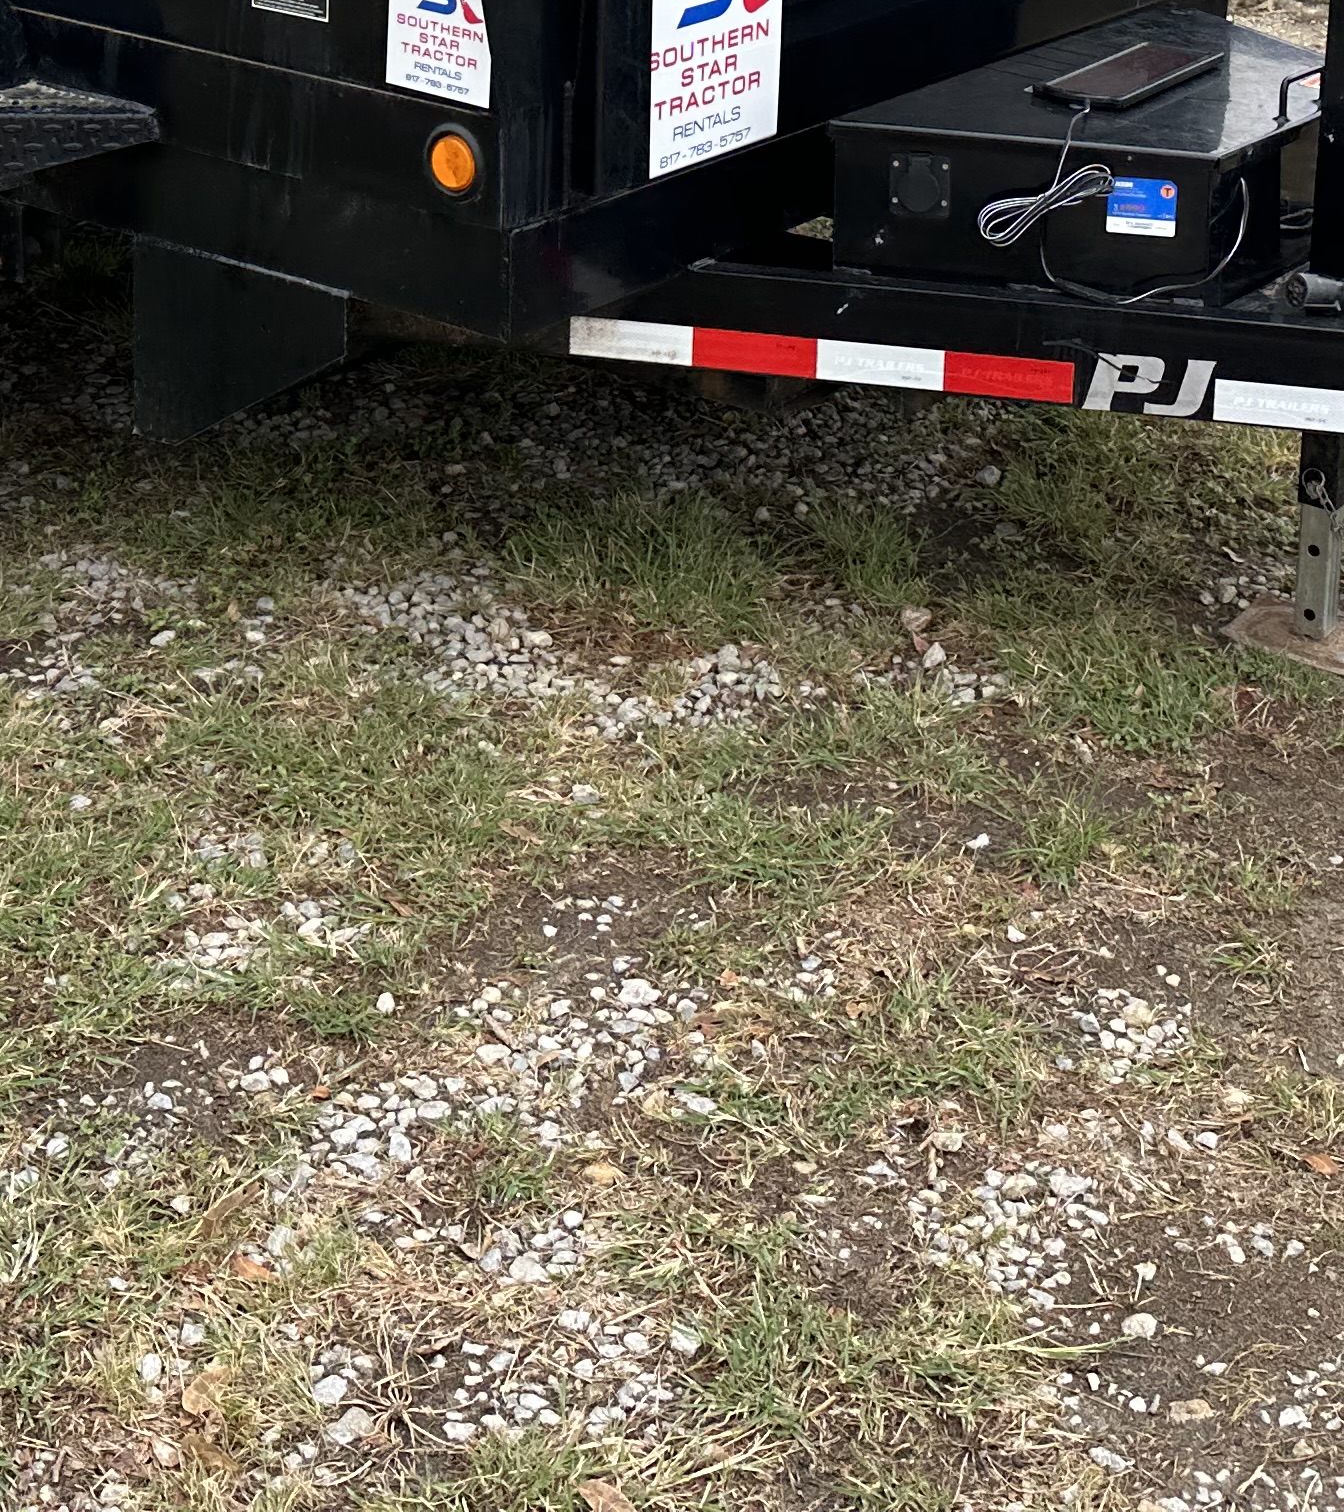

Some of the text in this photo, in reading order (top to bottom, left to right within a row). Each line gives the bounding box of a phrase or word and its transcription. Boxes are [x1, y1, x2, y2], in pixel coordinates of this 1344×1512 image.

[396, 13, 484, 44] SOUTHERN
[419, 32, 460, 52] STAR
[649, 18, 770, 72] SOUTHERN
[400, 41, 477, 70] TRACTOR
[413, 61, 463, 81] RENTALS
[680, 53, 738, 88] STAR
[653, 70, 761, 121] TRACTOR
[672, 105, 741, 143] RENTALS
[659, 126, 752, 170] 817-783-5757
[1081, 351, 1218, 417] PJ
[1258, 398, 1330, 415] TRAILERS
